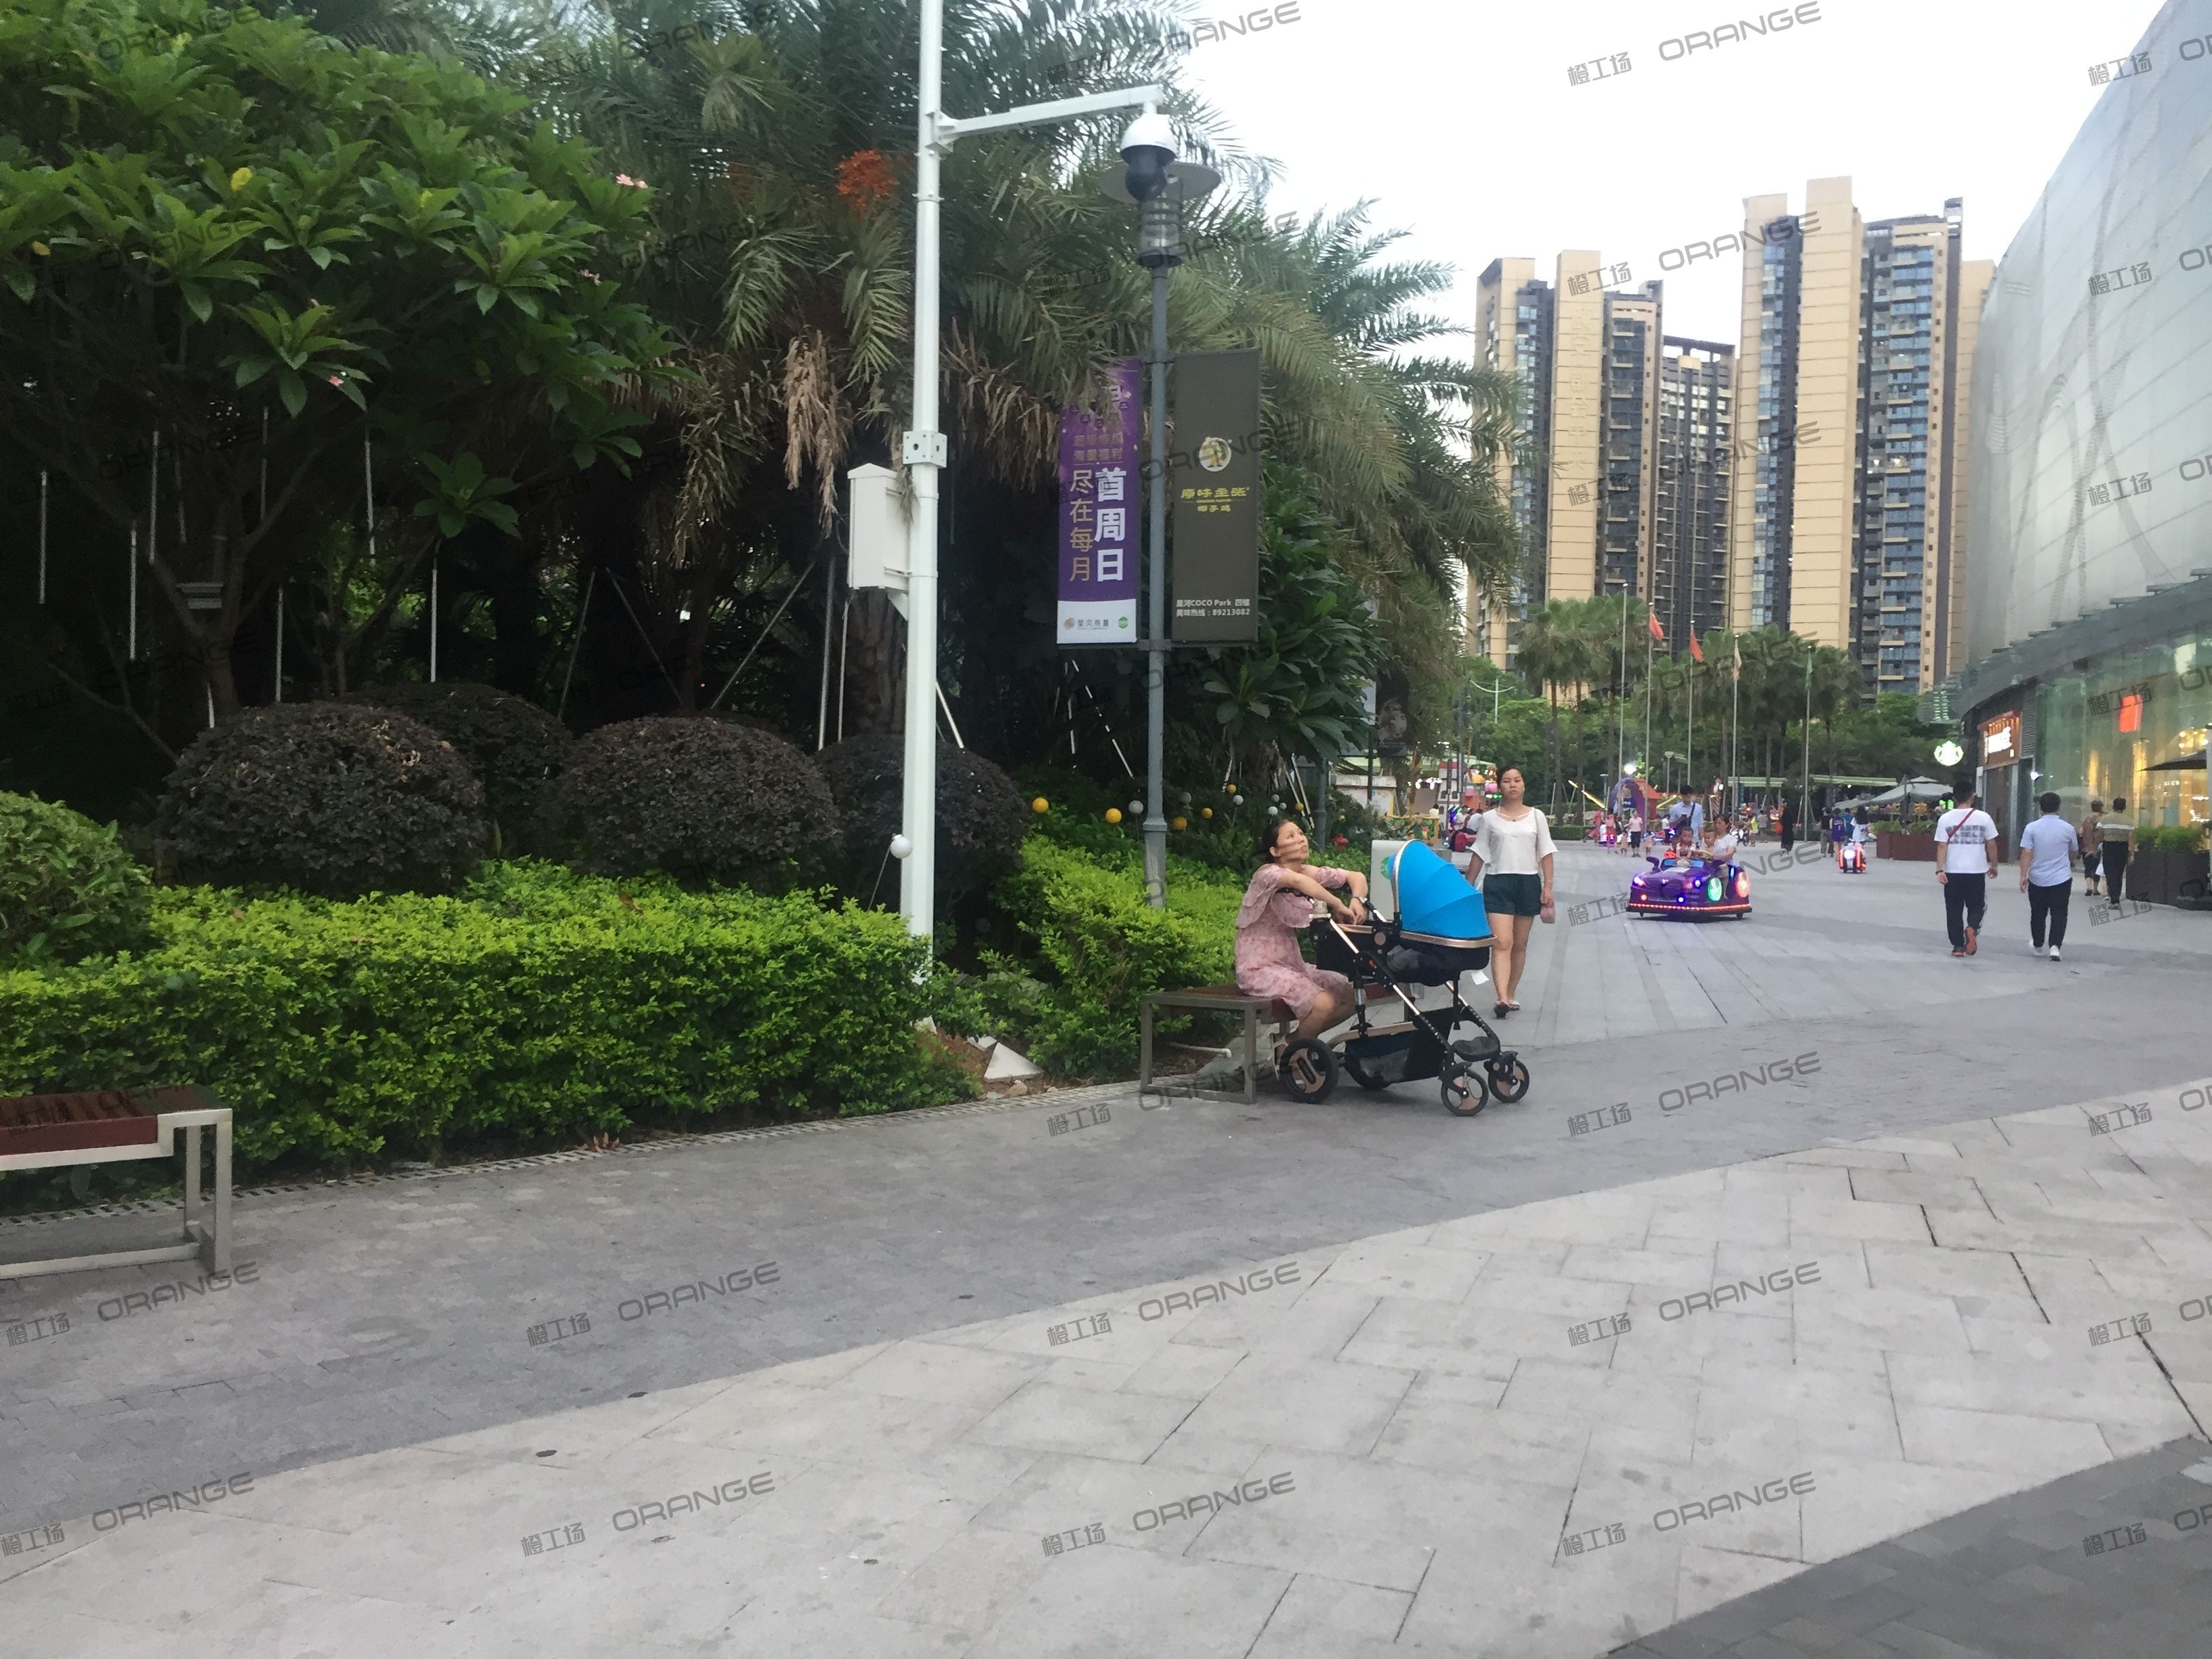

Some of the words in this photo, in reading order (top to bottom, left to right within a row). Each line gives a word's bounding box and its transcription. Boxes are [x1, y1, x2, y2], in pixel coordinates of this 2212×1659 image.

[1069, 470, 1093, 582] 尽在每月
[1095, 467, 1126, 582] 首周日
[1181, 487, 1247, 499] 原味主张
